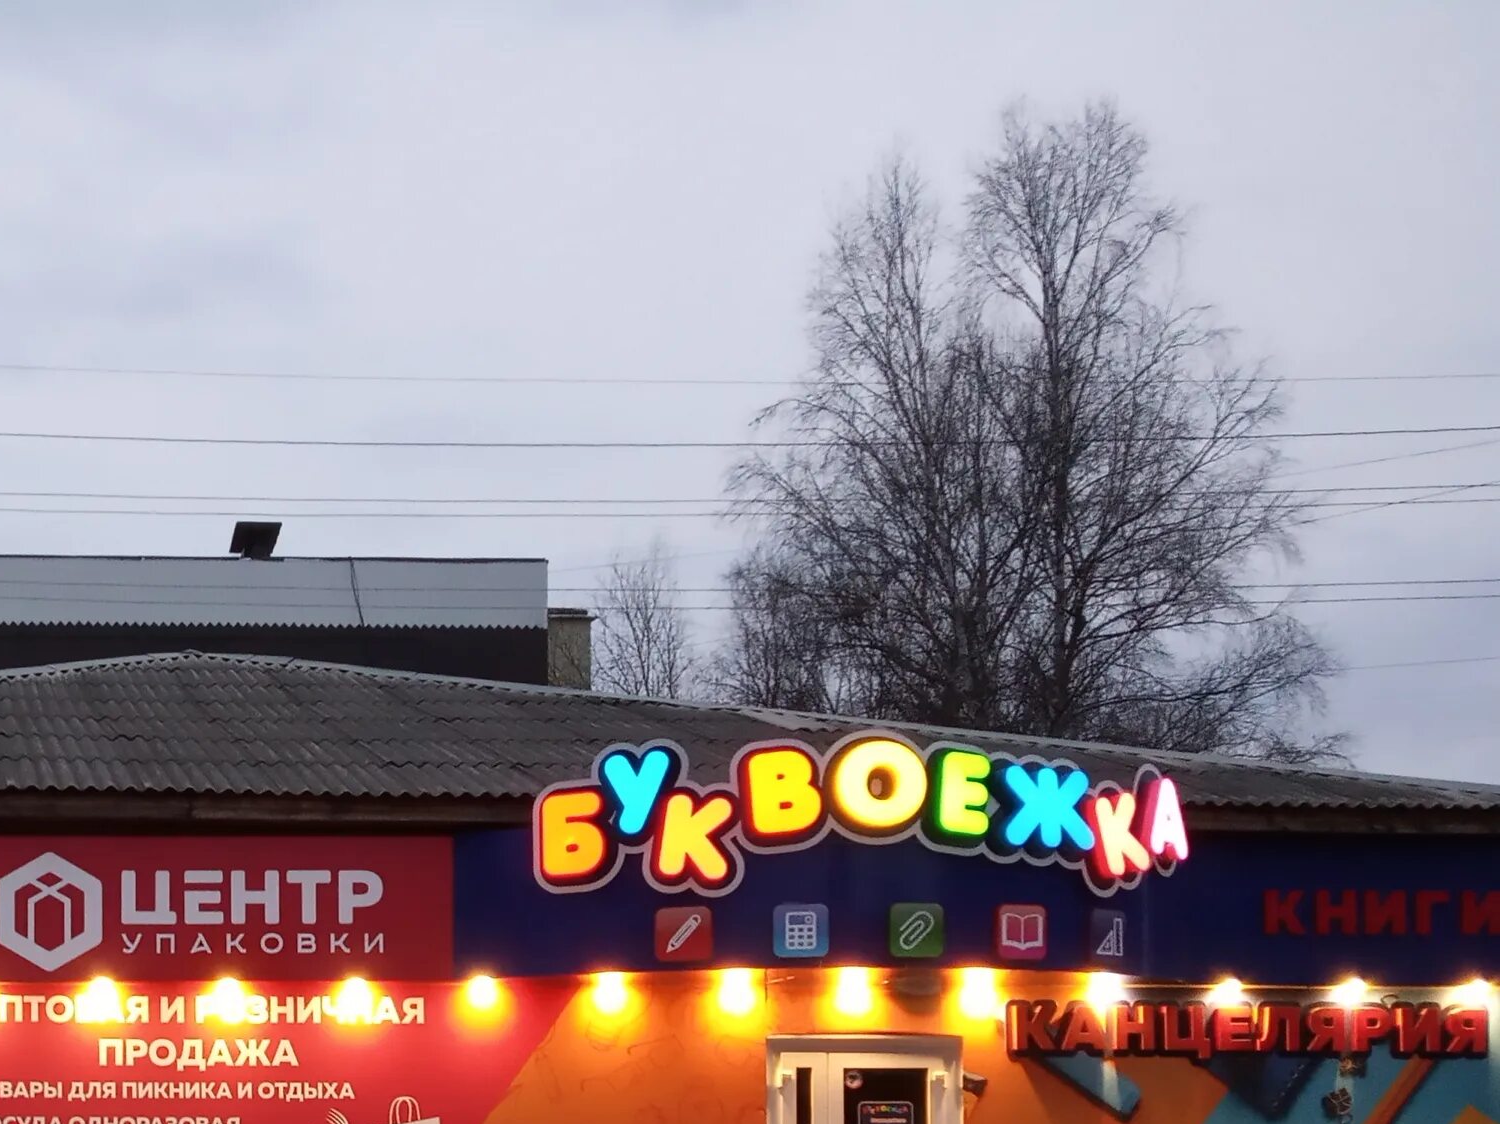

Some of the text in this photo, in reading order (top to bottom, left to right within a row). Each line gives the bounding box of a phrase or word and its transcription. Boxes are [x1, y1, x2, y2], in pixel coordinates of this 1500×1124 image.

[536, 737, 1190, 883] БУКВОЕЖКА
[119, 869, 384, 926] ЦЕНТР
[1263, 888, 1500, 936] КНИГИ
[121, 931, 385, 955] УПАКОВКИ
[159, 996, 185, 1024] И
[195, 995, 425, 1025] РЗНИЧАЯ
[1006, 1000, 1489, 1062] КАНЦЕЛЯРИЯ
[98, 1037, 300, 1071] ПРОДАЖА
[67, 1081, 117, 1102] ДЛЯ
[122, 1081, 233, 1100] ПИКНИКА
[237, 1082, 253, 1099] И
[257, 1082, 356, 1103] ОТДЫХА
